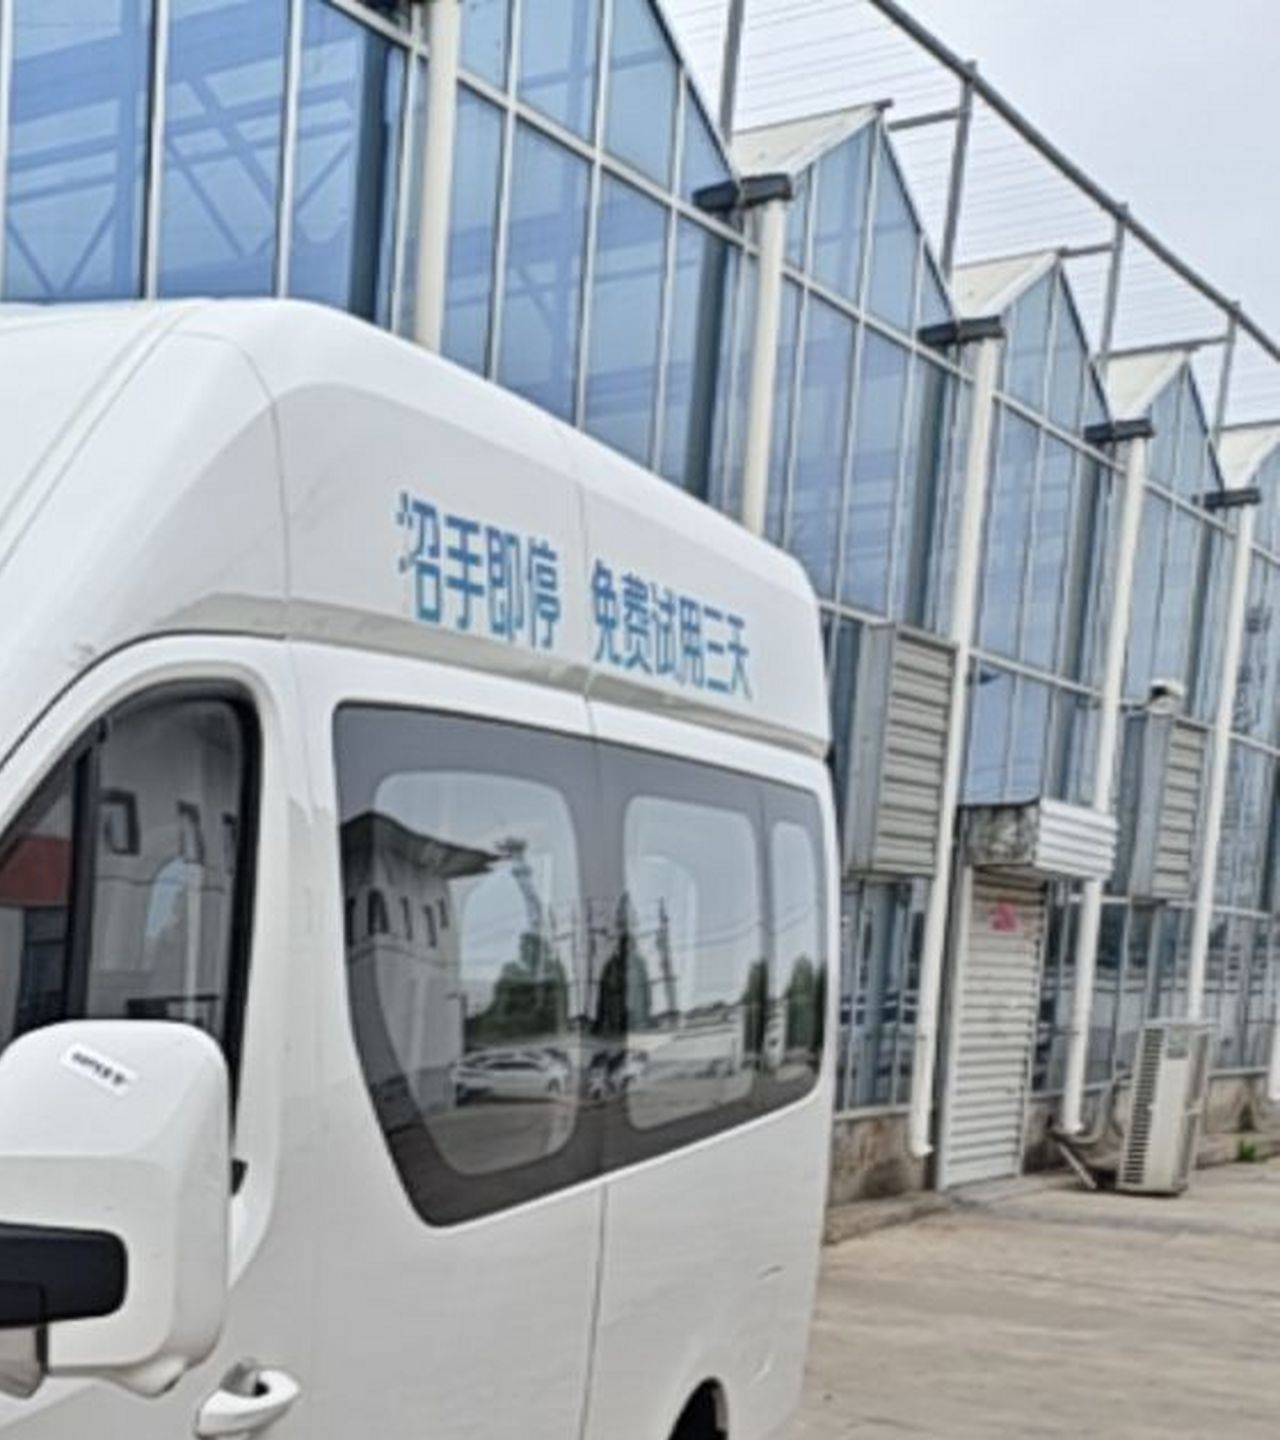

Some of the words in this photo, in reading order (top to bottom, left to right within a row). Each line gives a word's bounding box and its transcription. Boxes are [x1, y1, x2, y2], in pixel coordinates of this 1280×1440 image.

[590, 559, 753, 699] 免费试用三天
